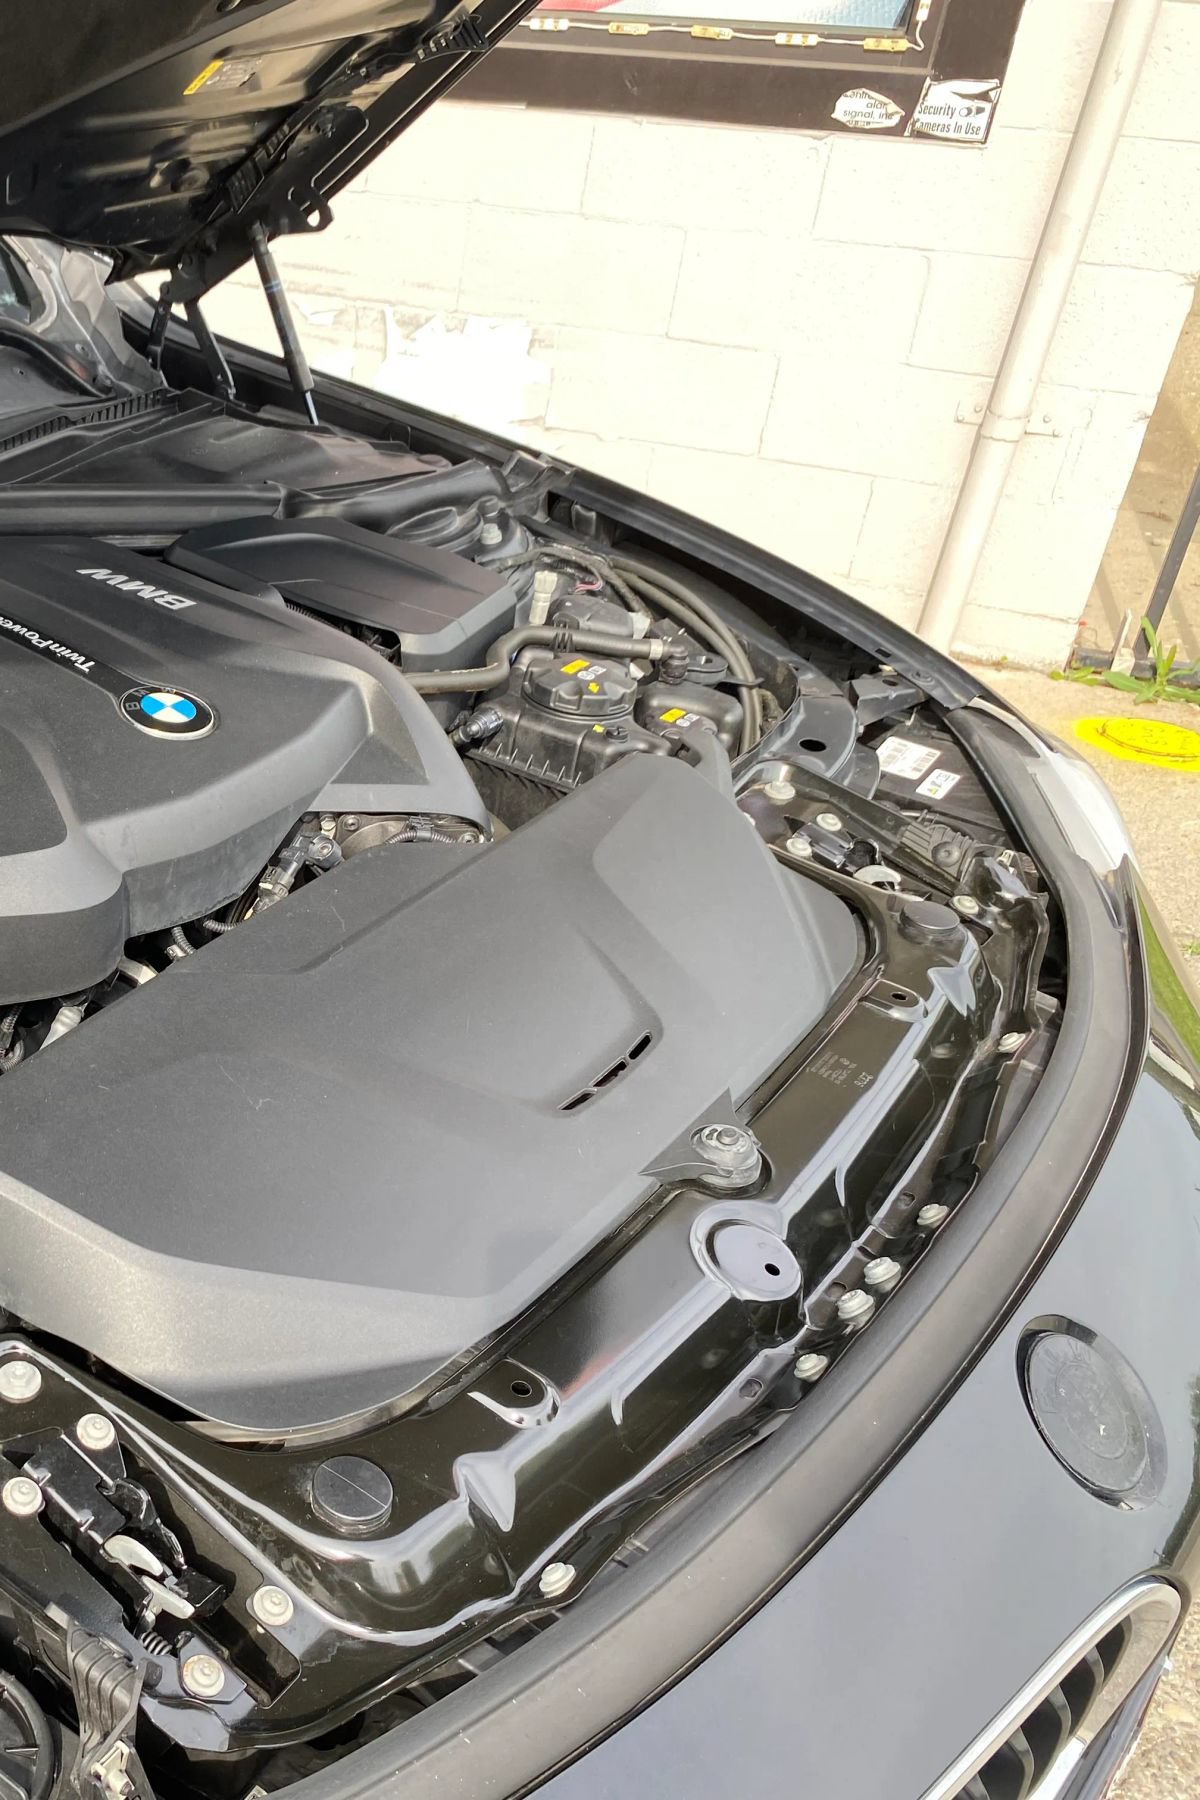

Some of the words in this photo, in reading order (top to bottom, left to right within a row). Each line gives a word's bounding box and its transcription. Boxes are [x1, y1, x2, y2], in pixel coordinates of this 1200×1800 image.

[918, 102, 957, 119] Security
[953, 121, 963, 134] In
[964, 122, 982, 135] Use
[76, 568, 197, 610] BMW
